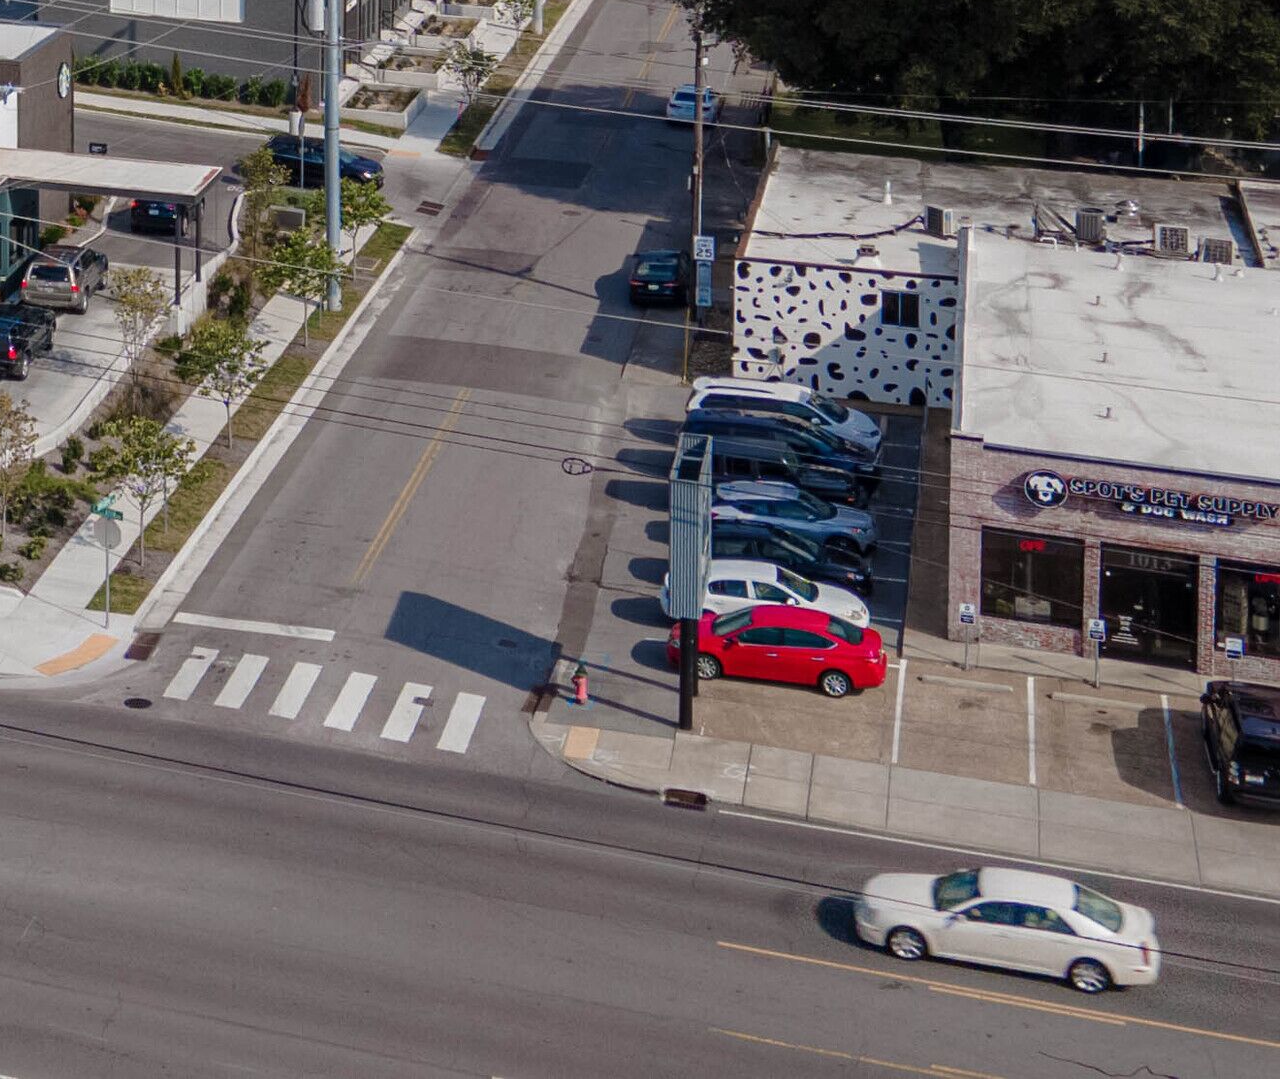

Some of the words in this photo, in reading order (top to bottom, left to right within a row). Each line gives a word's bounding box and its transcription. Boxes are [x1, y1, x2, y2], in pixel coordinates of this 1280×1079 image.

[696, 248, 713, 258] 25
[1070, 478, 1146, 501] SPOT'S
[1151, 488, 1191, 509] PET
[1198, 495, 1280, 519] SUPPLY
[1141, 504, 1174, 518] DOG
[1181, 509, 1228, 525] WASH
